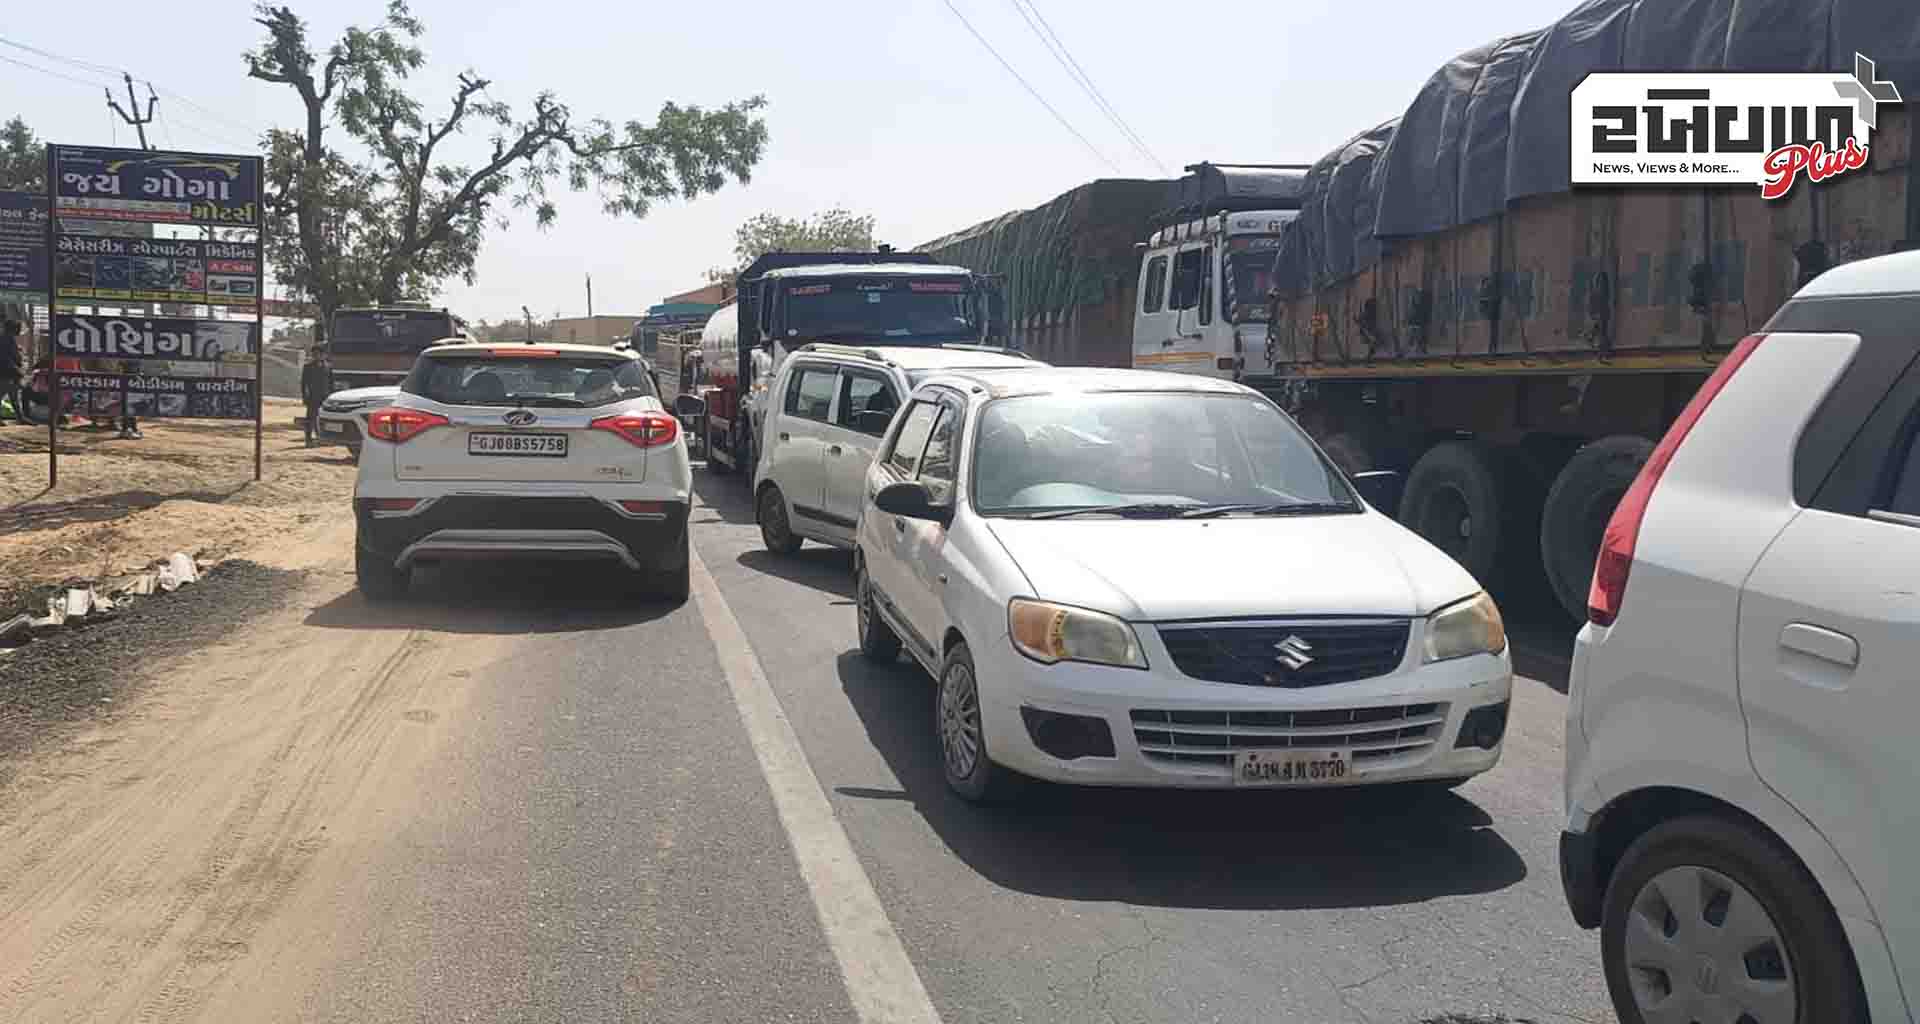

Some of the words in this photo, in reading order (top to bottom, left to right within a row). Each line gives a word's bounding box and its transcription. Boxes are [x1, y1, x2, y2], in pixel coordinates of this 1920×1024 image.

[63, 171, 121, 195] જય
[143, 168, 230, 201] ગોગા
[57, 317, 193, 357] વોશિંગ
